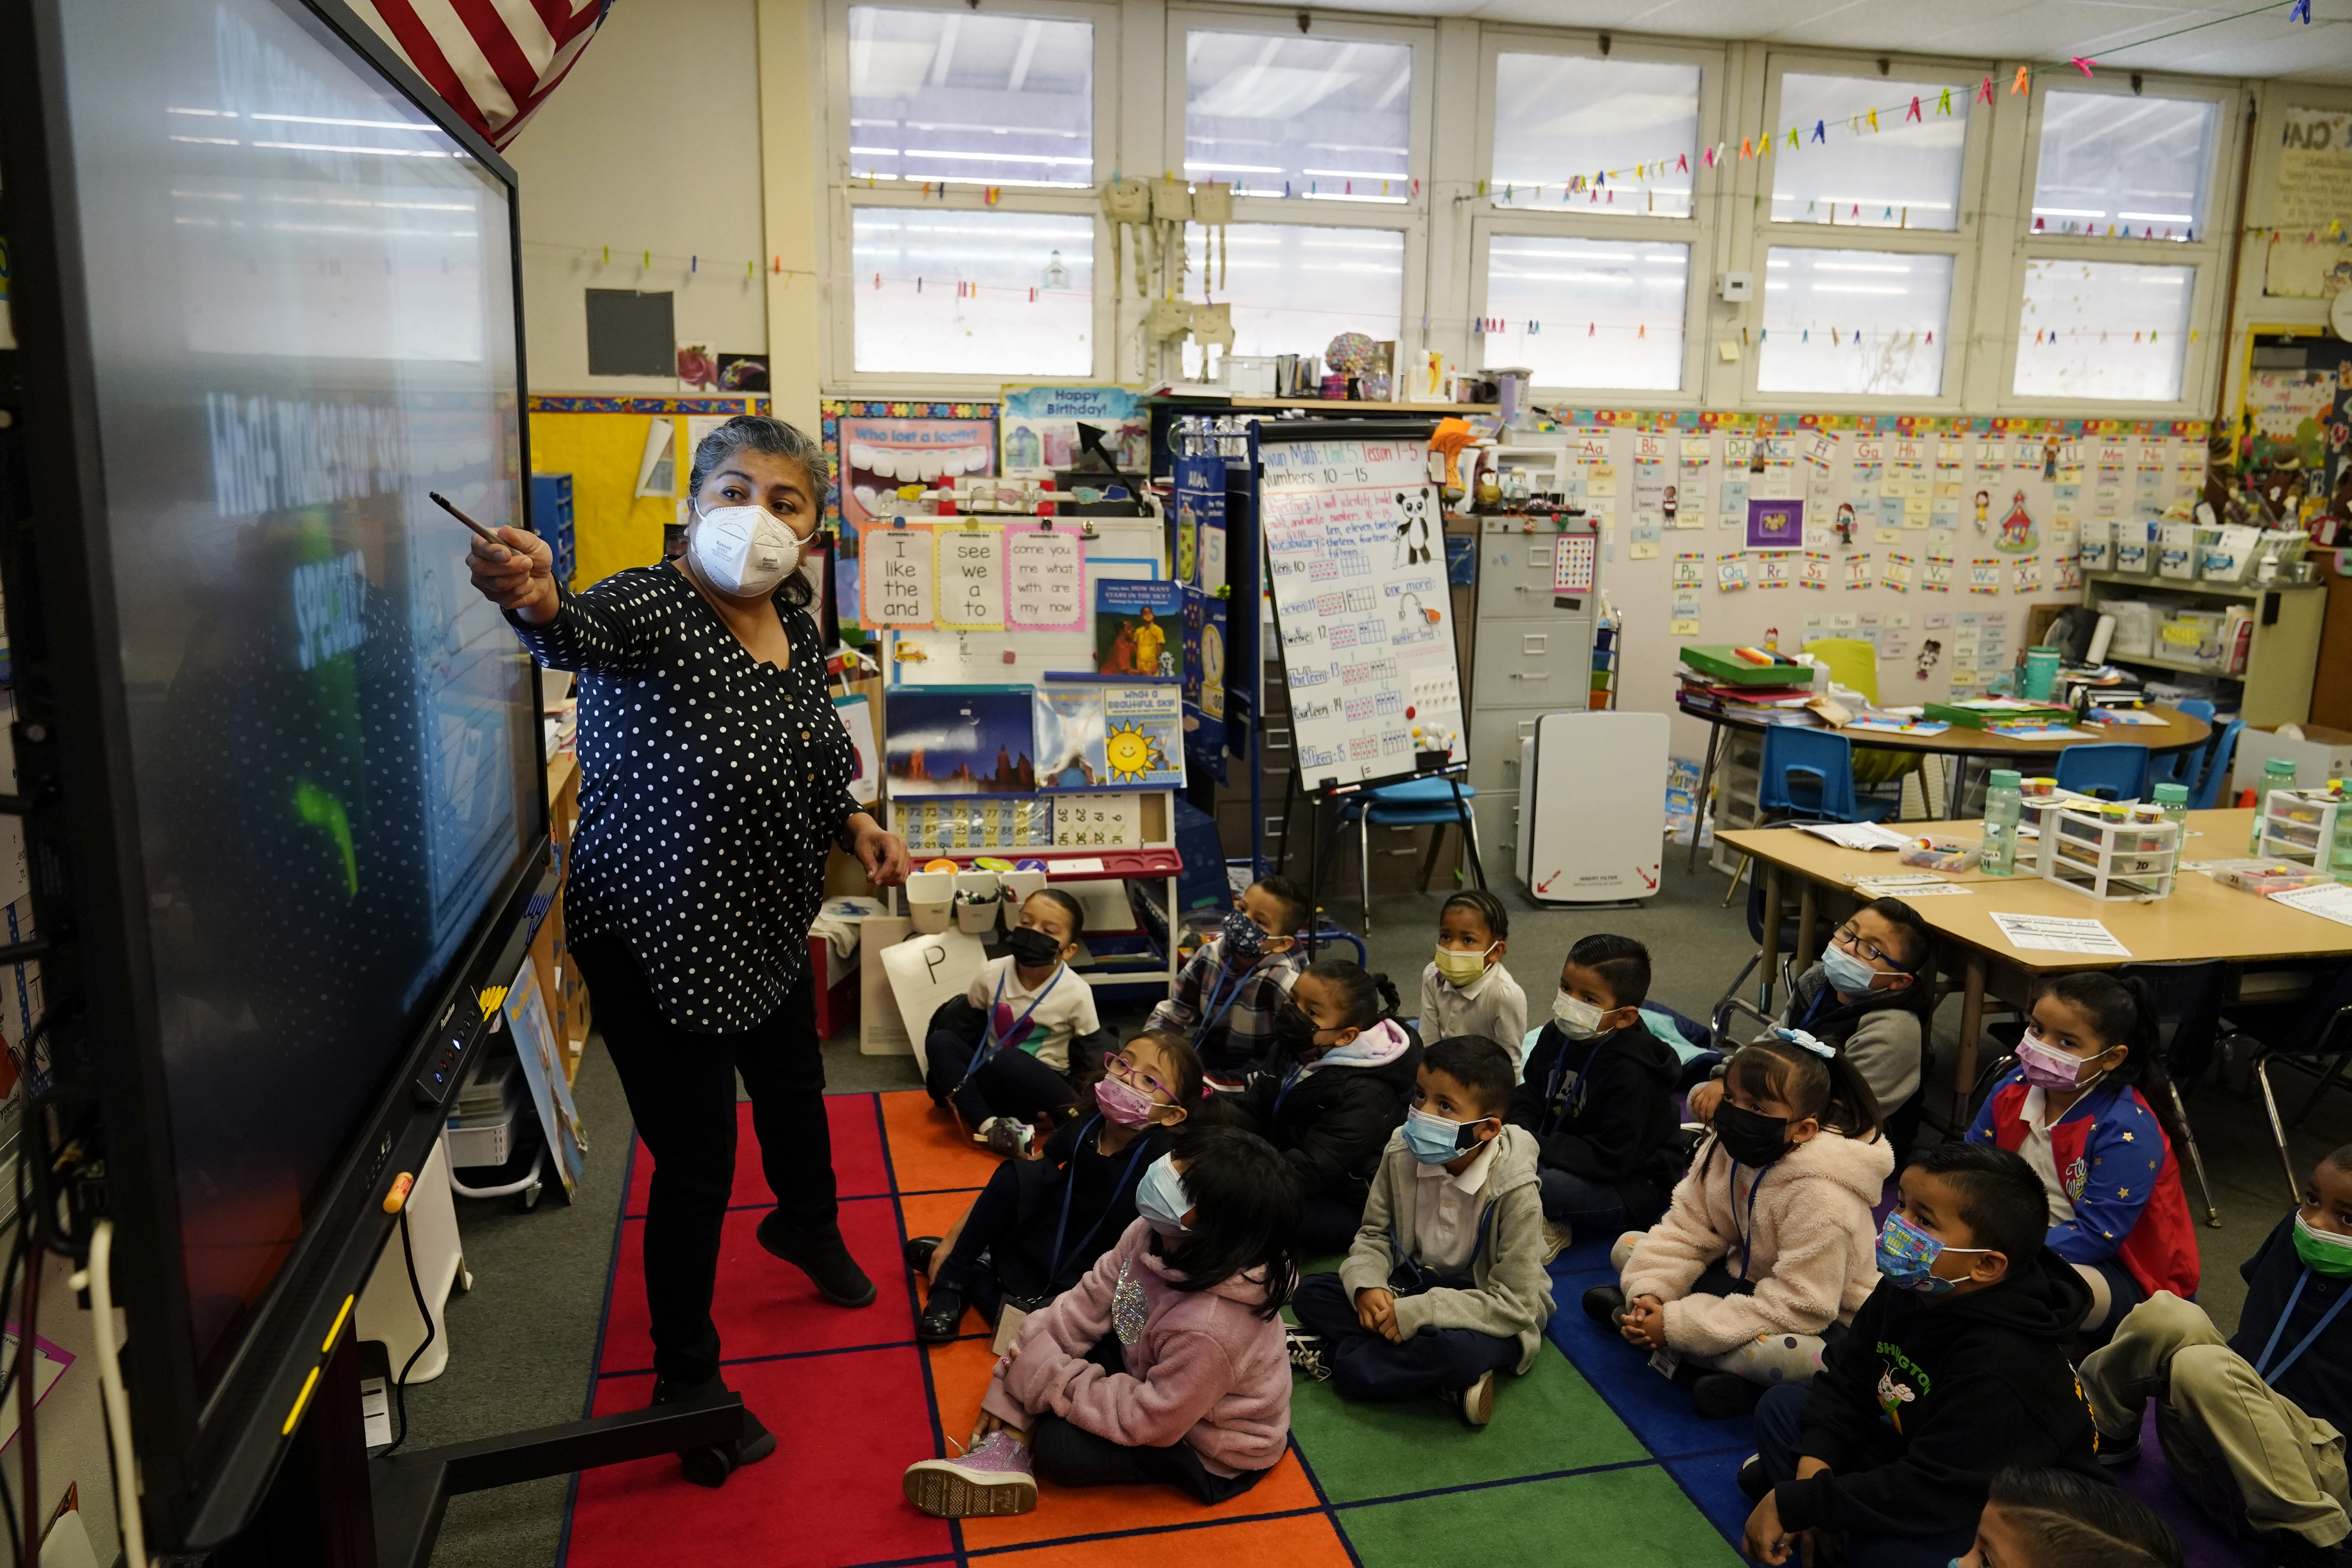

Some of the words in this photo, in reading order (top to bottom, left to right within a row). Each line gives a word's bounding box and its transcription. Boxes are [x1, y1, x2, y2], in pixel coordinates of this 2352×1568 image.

[1055, 390, 1100, 403] Happy
[1047, 404, 1107, 417] Birthday!
[856, 427, 887, 441] Who
[892, 431, 917, 442] lost
[920, 433, 930, 443] a
[935, 429, 979, 441] tooth?
[1584, 440, 1603, 455] Aa
[1642, 438, 1657, 454] Bb
[1687, 439, 1703, 454] Cc
[1729, 441, 1746, 456] Dd
[1773, 441, 1788, 456] Ee
[1814, 440, 1829, 456] Ff
[1858, 443, 1879, 461] Gg
[1898, 443, 1916, 457] Hh
[1984, 445, 1994, 461] Jj
[1263, 469, 1315, 488] Numbers
[717, 541, 732, 551] Raxwell
[896, 541, 905, 557] I
[958, 546, 991, 558] see
[1013, 546, 1044, 554] come
[1050, 547, 1070, 557] you
[886, 561, 916, 577] like
[962, 566, 987, 578] we
[1020, 565, 1038, 573] me
[1046, 564, 1074, 574] what
[1294, 561, 1305, 573] 10
[1682, 564, 1695, 581] Pp
[1722, 565, 1744, 581] Qq
[1768, 564, 1781, 578] Rr
[1808, 563, 1822, 578] Ss
[1852, 564, 1863, 579] Tt
[1931, 567, 1944, 581] Vv
[1973, 570, 1996, 581] Ww
[2020, 567, 2036, 584] Xx
[2061, 566, 2074, 584] Yy
[884, 580, 918, 597] the
[969, 586, 980, 597] a
[1018, 583, 1042, 593] with
[884, 601, 918, 616] and
[964, 601, 985, 616] to
[1020, 604, 1039, 614] my
[1050, 604, 1073, 612] now
[1318, 625, 1328, 639] 12
[1679, 623, 1690, 633] put
[909, 808, 921, 817] 72
[925, 808, 936, 817] 73
[986, 809, 998, 818] 77
[1002, 809, 1013, 818] 78
[1058, 809, 1068, 822] 39
[1076, 808, 1086, 822] 29
[1094, 812, 1104, 822] 19
[1058, 832, 1068, 846] 40
[2136, 861, 2149, 870] 20
[924, 945, 946, 985] P
[1886, 1236, 1904, 1250] HO!
[1896, 1230, 1913, 1244] HO!
